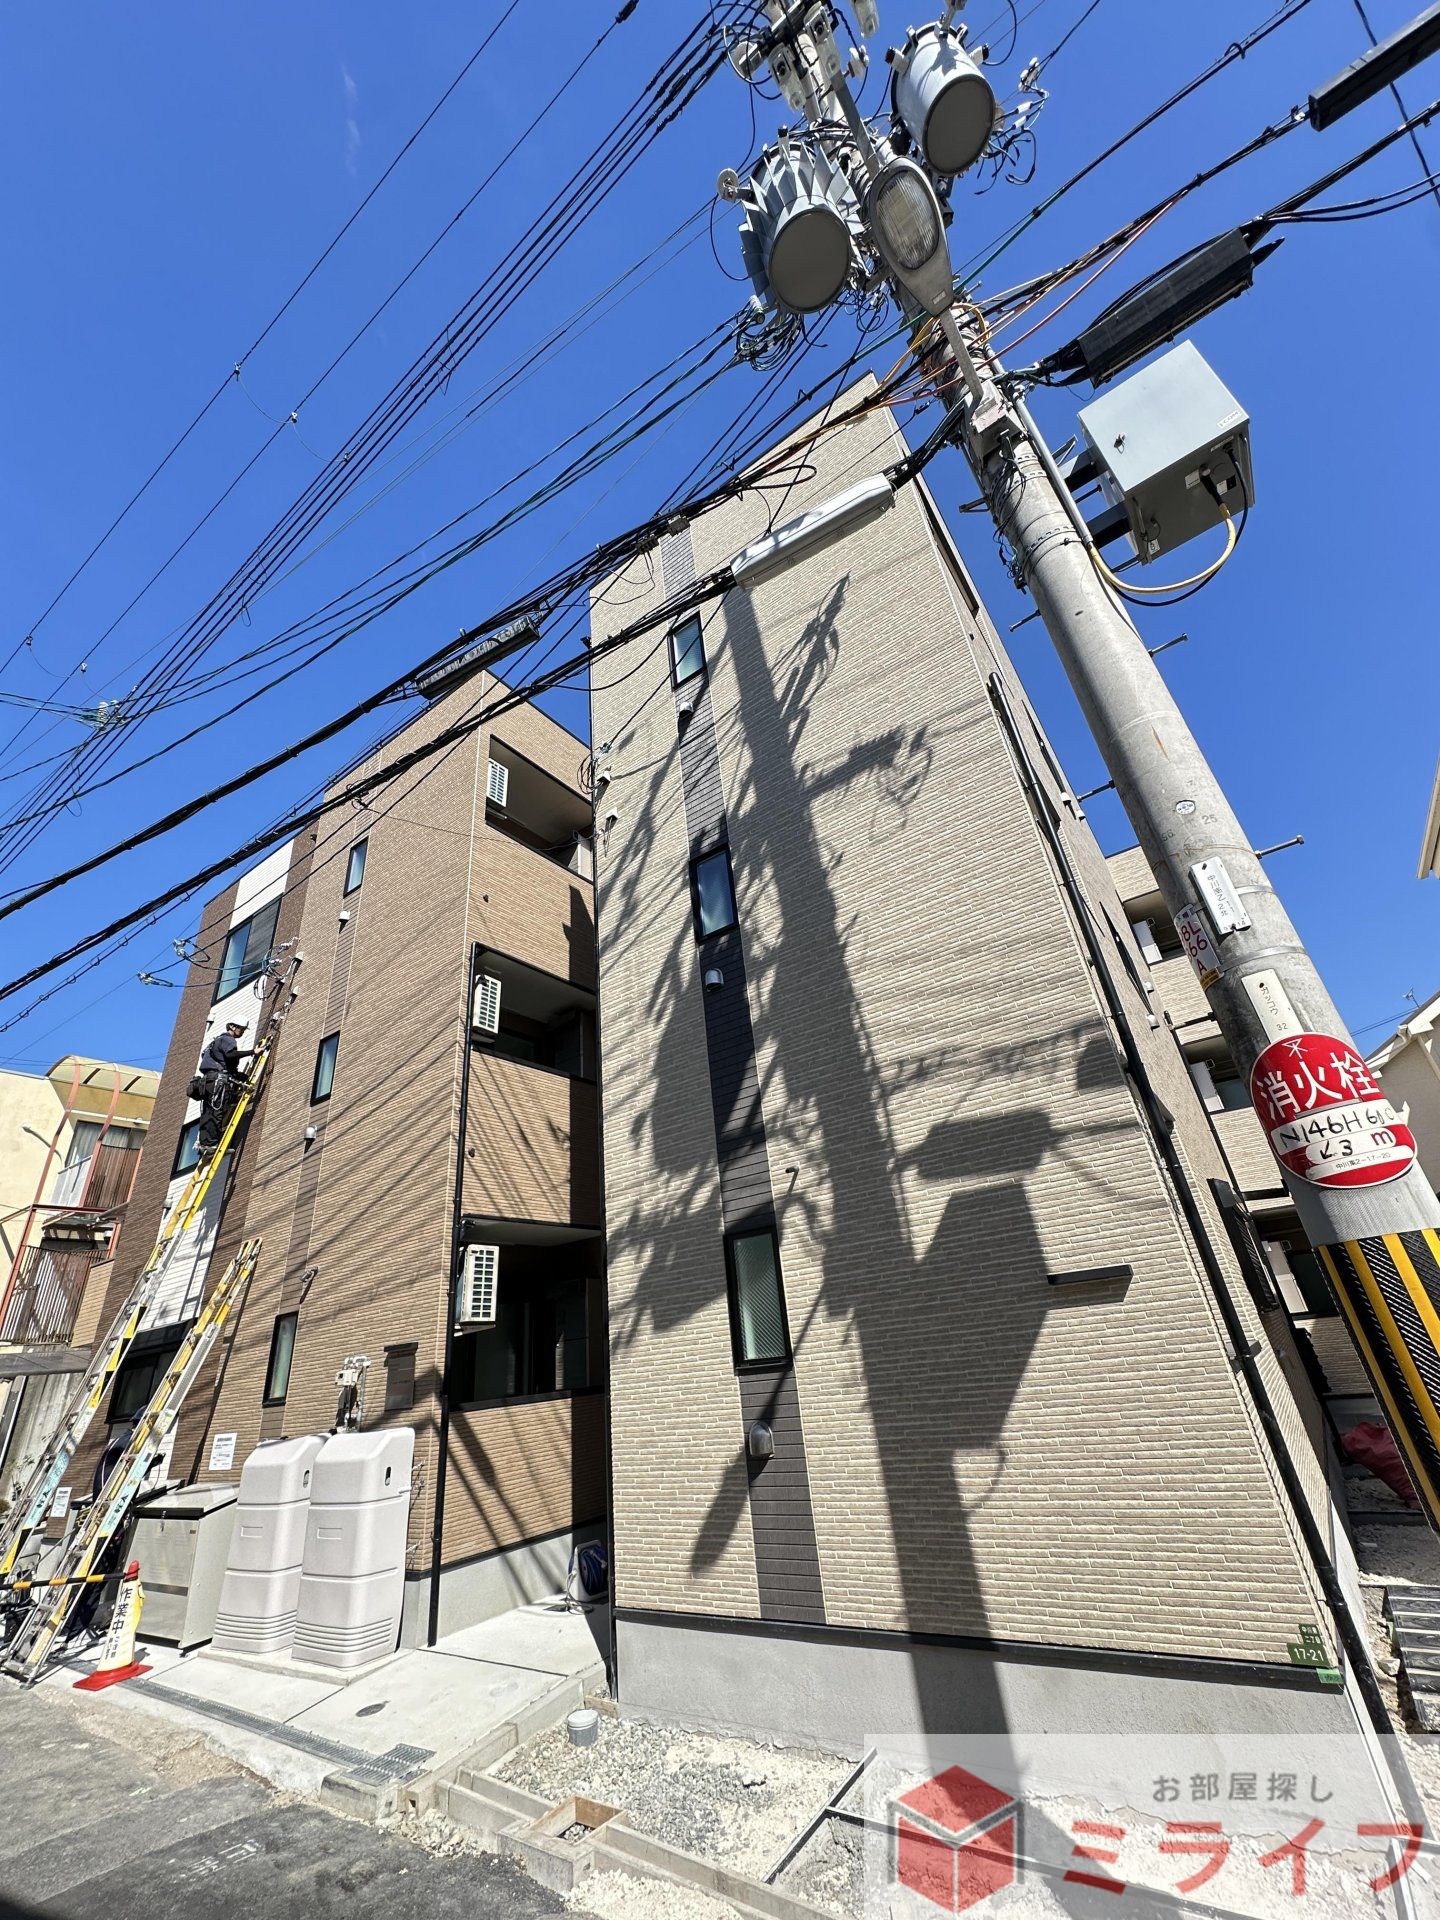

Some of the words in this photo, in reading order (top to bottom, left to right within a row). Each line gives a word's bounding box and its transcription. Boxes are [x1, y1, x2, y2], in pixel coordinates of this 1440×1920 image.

[1256, 1050, 1380, 1120] 消火栓
[1370, 1131, 1394, 1146] m
[112, 1587, 133, 1635] 作業中
[1293, 1647, 1325, 1662] 17-21
